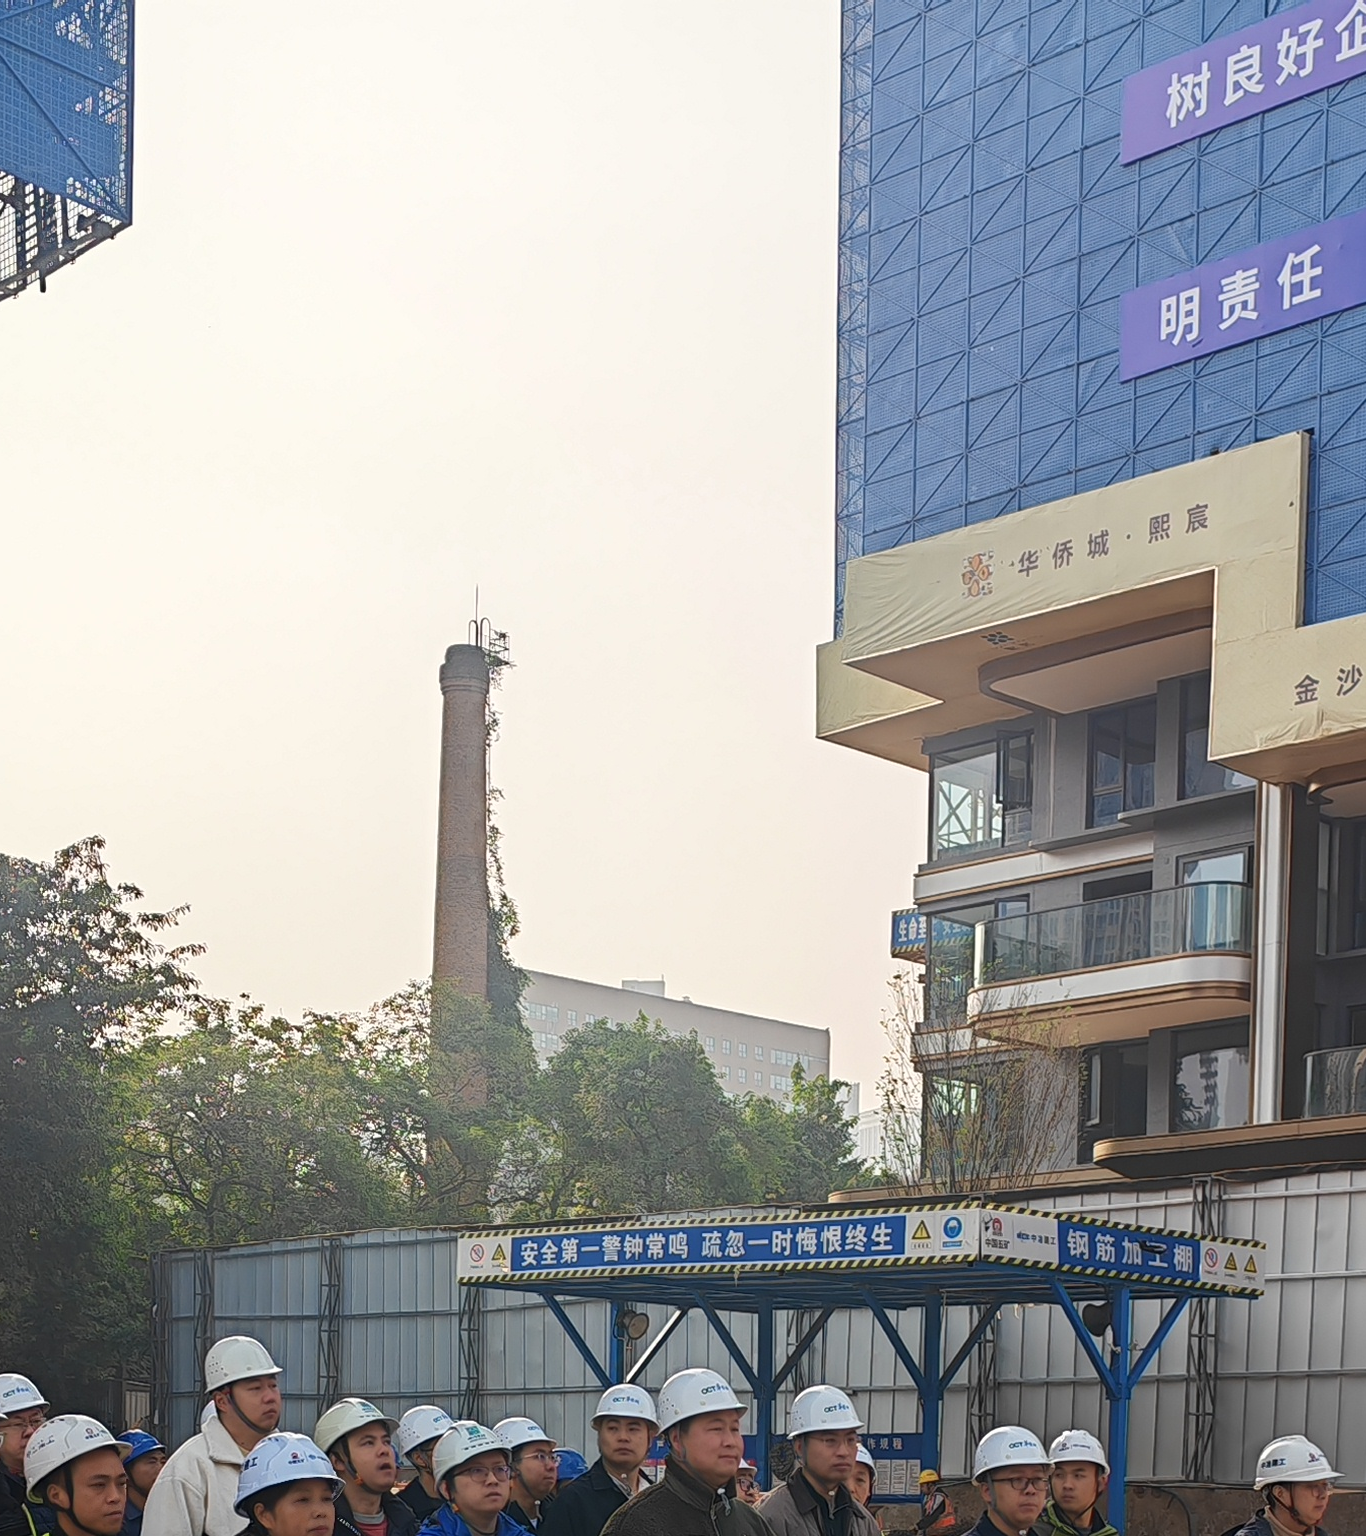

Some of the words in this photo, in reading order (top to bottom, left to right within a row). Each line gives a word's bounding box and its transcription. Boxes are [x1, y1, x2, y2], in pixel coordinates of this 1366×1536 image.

[1159, 244, 1323, 346] 明责任
[520, 1231, 689, 1267] 安全第一警钟常鸣
[700, 1221, 894, 1259] 疏忽一时悔恨终生
[1066, 1228, 1194, 1274] 钢筋加工棚
